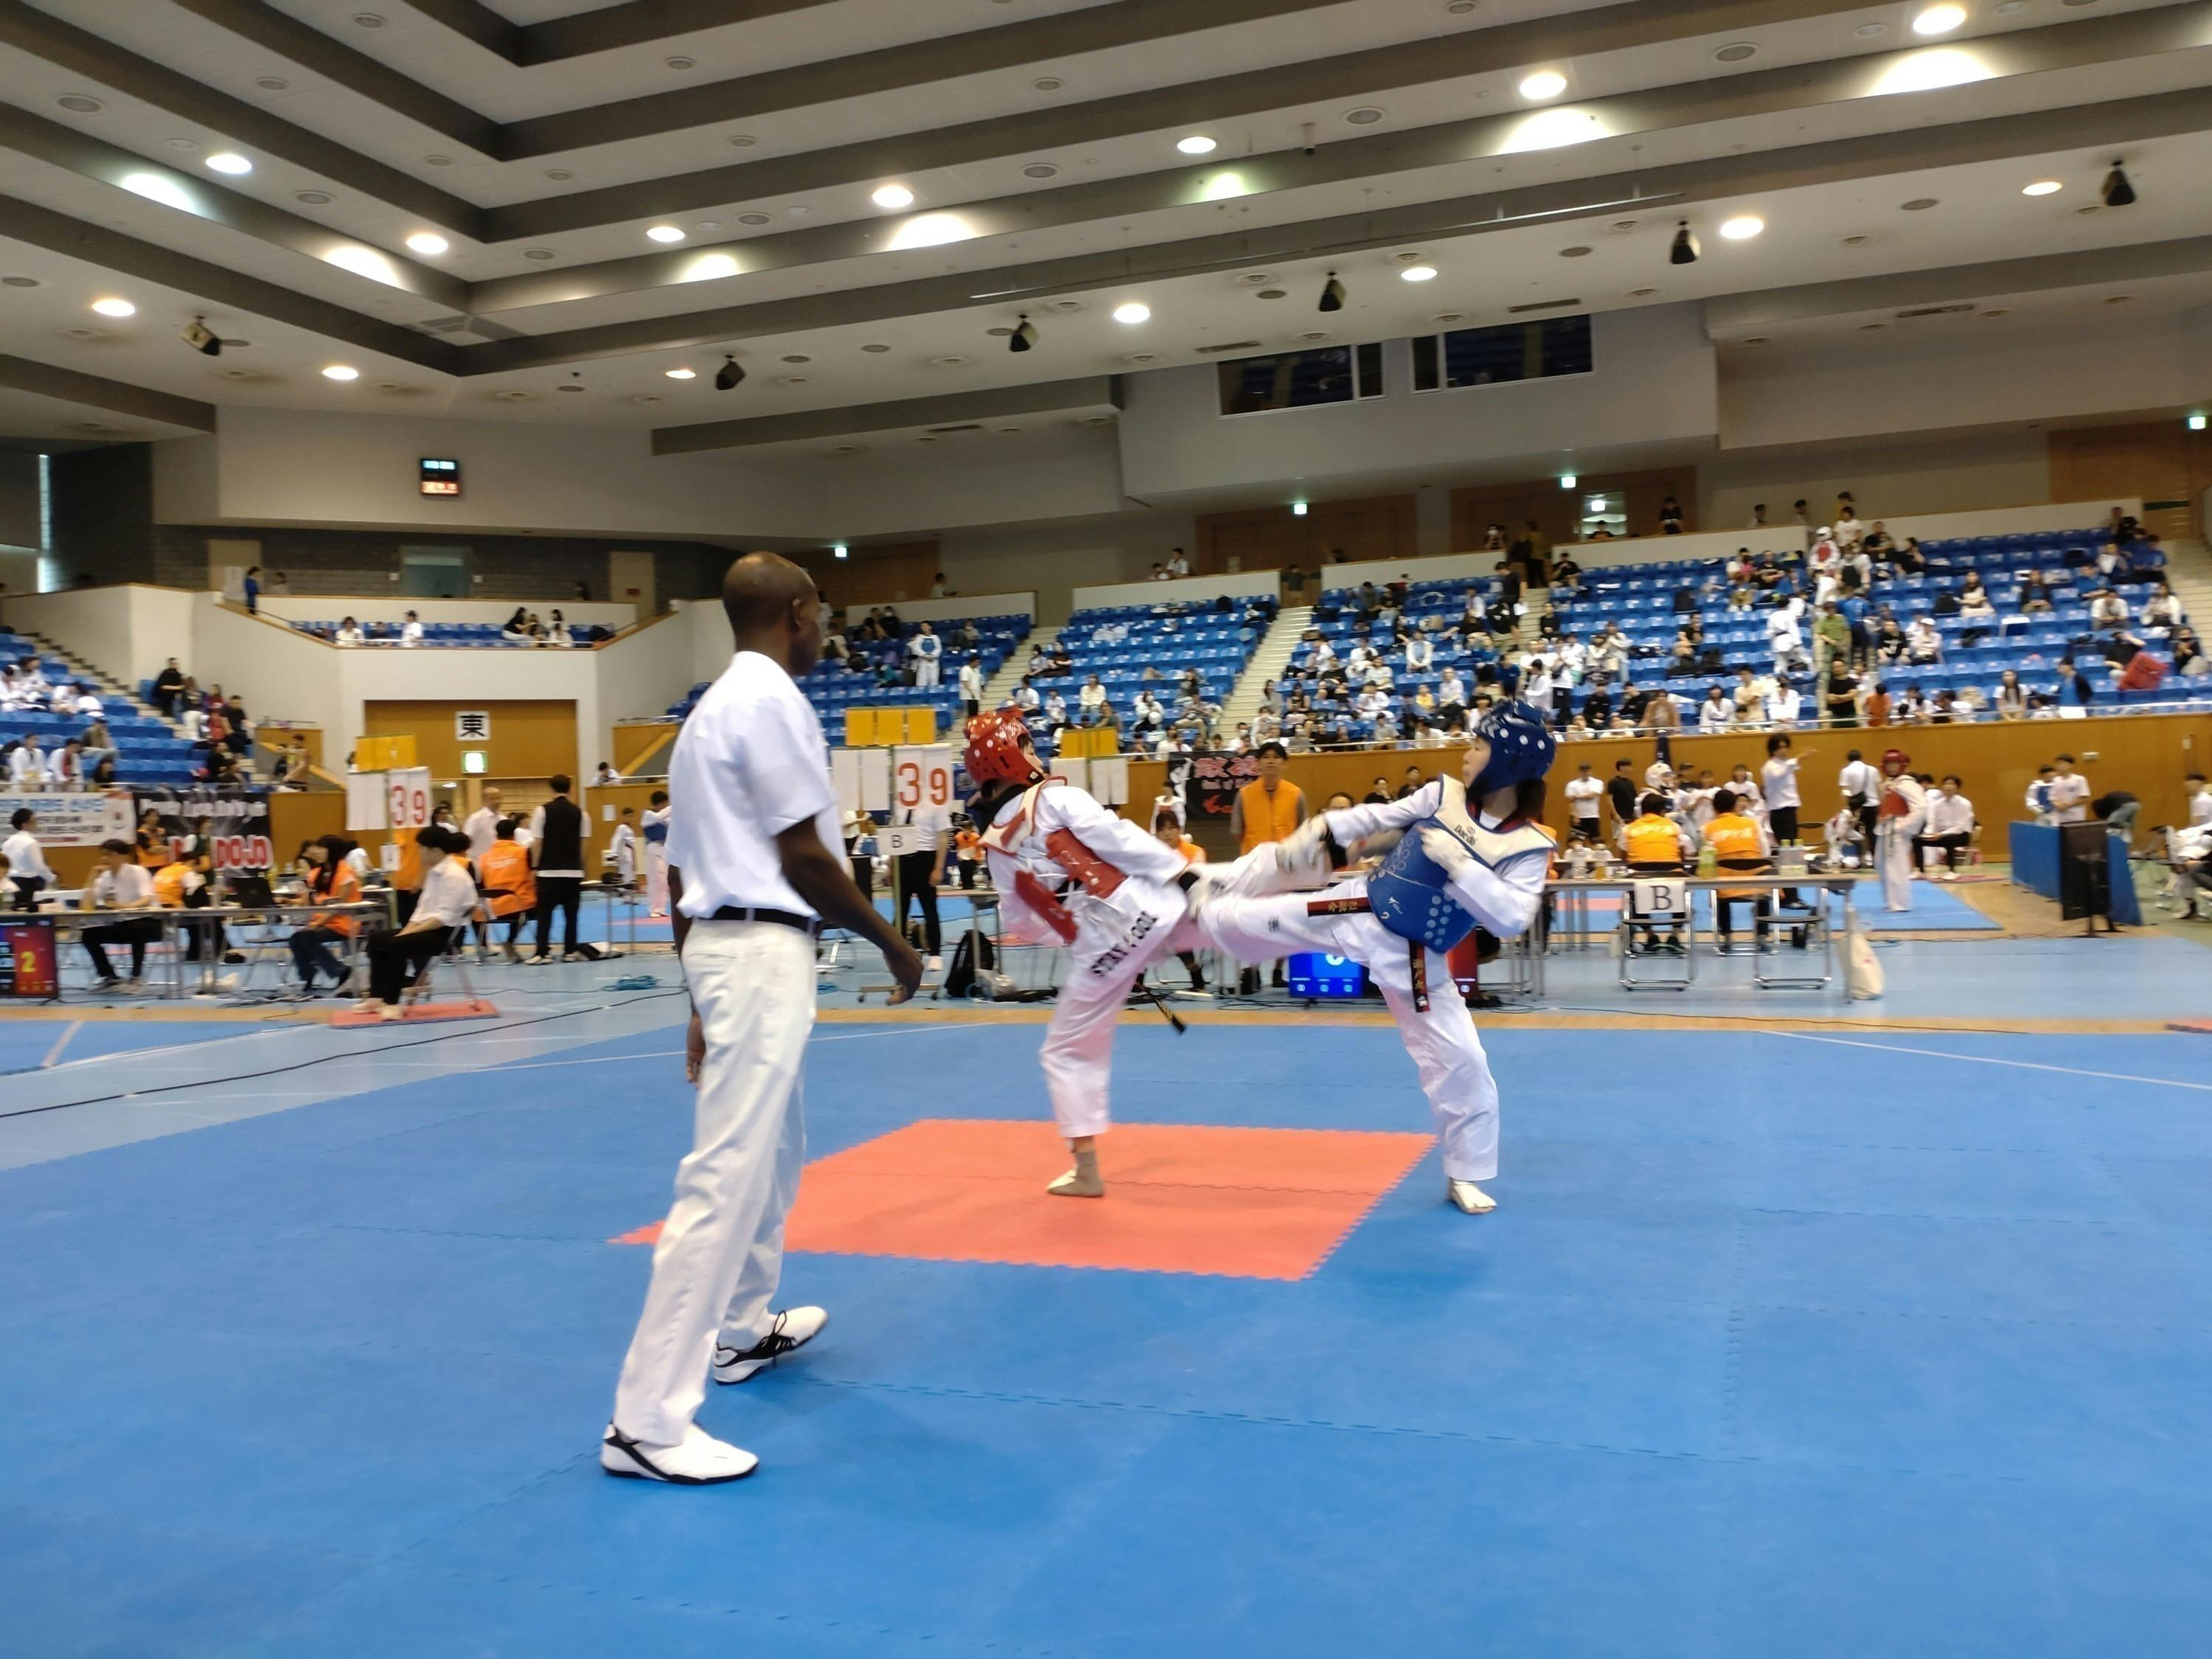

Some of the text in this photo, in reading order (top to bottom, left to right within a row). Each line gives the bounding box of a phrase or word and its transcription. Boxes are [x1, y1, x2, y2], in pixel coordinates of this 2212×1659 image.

[457, 714, 487, 738] 東
[898, 762, 948, 807] 39
[389, 785, 426, 826] 39
[891, 835, 903, 849] B
[1649, 885, 1672, 911] B
[20, 950, 37, 973] 2
